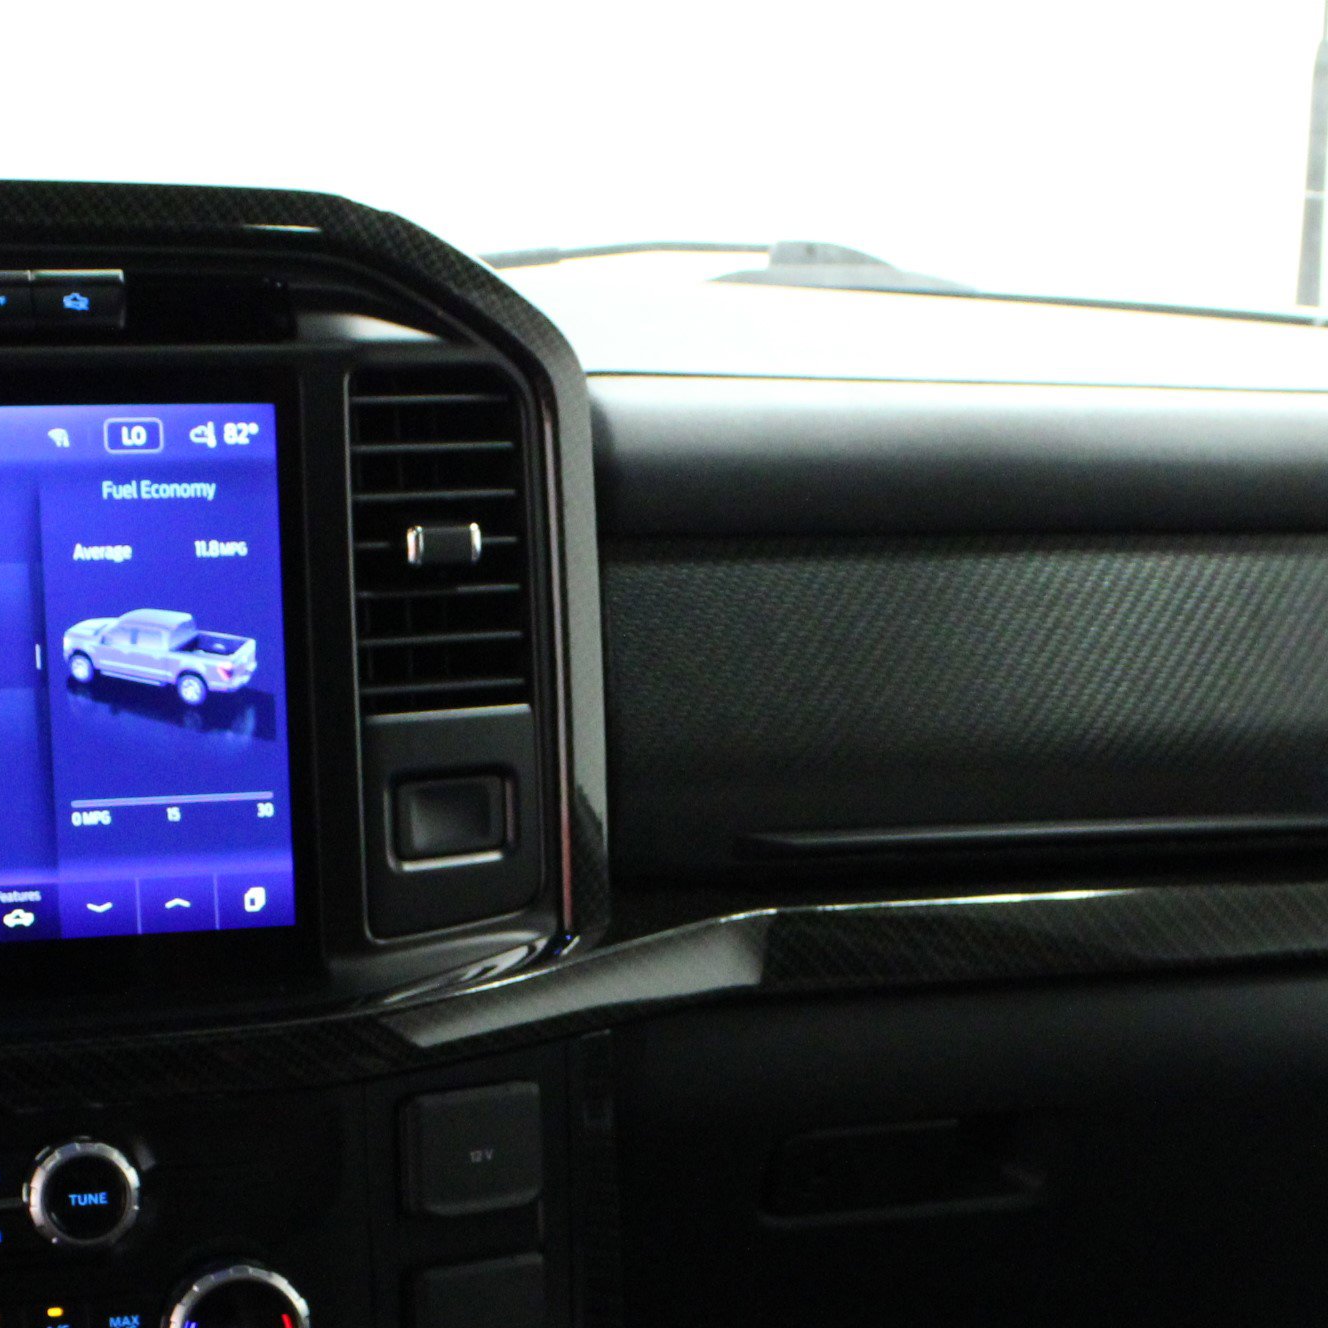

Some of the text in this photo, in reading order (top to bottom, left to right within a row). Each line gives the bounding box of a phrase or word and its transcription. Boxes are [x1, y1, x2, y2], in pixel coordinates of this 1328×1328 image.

[121, 422, 260, 446] LO 82°
[102, 479, 216, 501] Fuel Economy
[73, 543, 132, 563] Average
[72, 809, 112, 826] 0 MPG
[167, 807, 181, 822] 15
[257, 803, 274, 818] 30
[68, 1191, 108, 1208] TUNE
[109, 1314, 140, 1328] MAX
